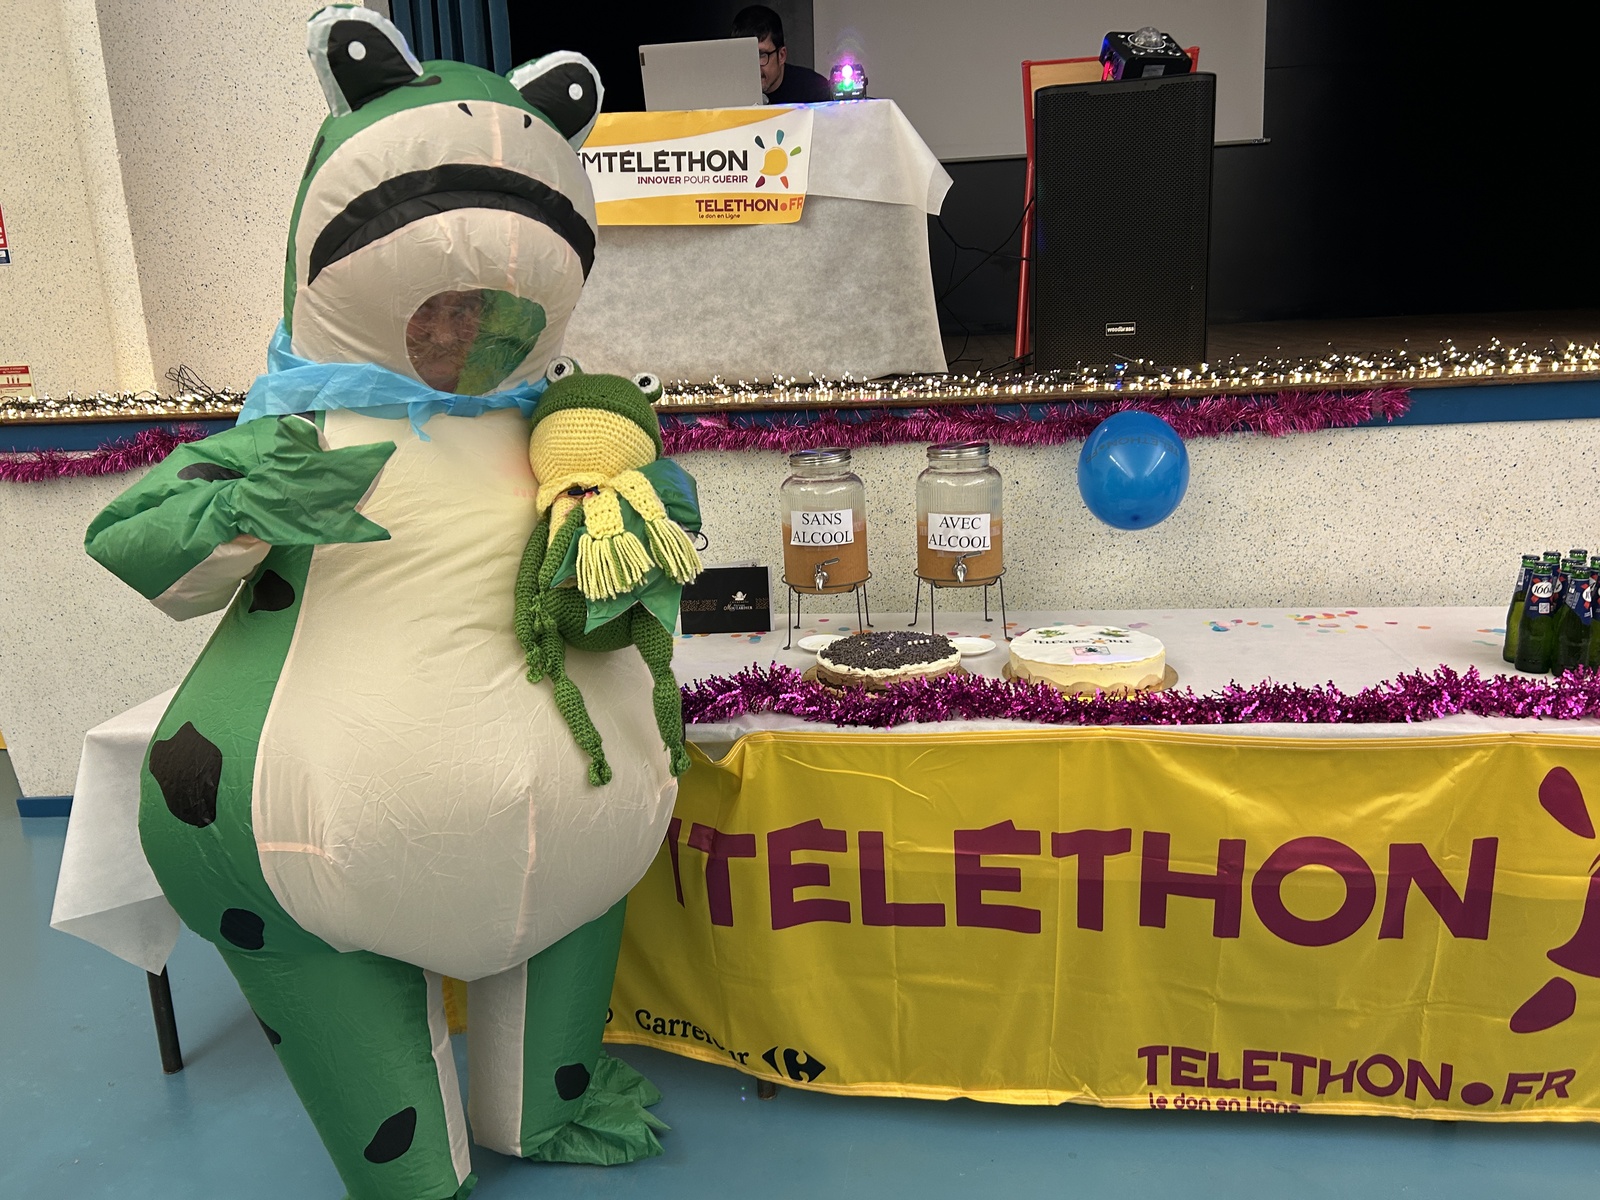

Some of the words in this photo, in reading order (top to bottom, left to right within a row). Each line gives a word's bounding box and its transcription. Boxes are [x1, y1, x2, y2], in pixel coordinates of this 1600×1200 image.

[576, 149, 748, 173] MTÉLÉTHON
[637, 176, 682, 184] INNOVER
[683, 175, 710, 184] POUR
[801, 512, 842, 526] SANS
[939, 516, 981, 530] AVEC
[792, 530, 853, 544] ALCOOL
[928, 533, 990, 548] ALCOOL
[1173, 1092, 1211, 1111] don
[1216, 1097, 1241, 1112] en
